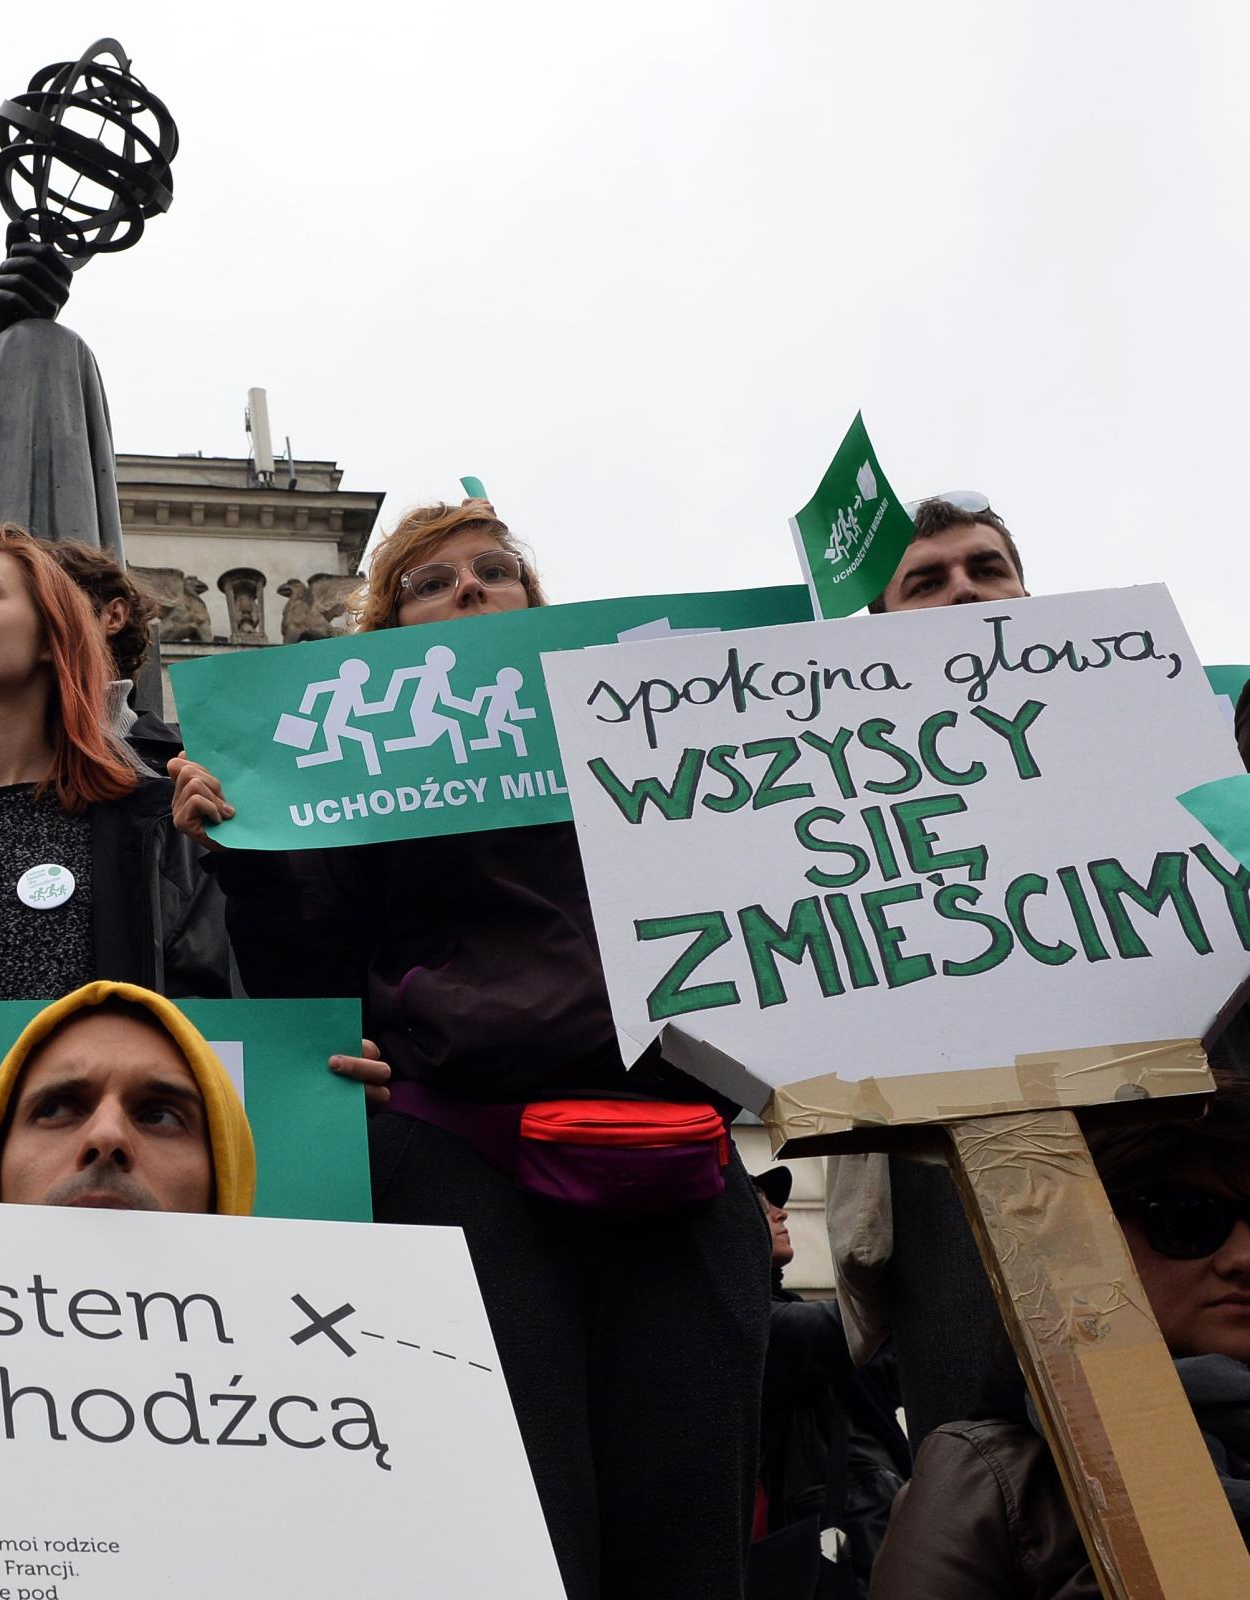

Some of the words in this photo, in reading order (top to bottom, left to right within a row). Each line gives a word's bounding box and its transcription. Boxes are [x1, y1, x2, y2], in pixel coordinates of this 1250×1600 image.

[588, 648, 913, 749] spokojna
[944, 616, 1183, 701] głowa,
[289, 776, 488, 827] UCHODŹCY
[500, 769, 569, 800] MIL
[587, 700, 1047, 824] WSZYSCY
[794, 794, 989, 888] SIĘ
[635, 843, 1250, 1022] ZMIEŚCIMY
[4, 1560, 80, 1580] Francji.
[44, 1537, 120, 1553] rodzice
[17, 1585, 58, 1600] pod
